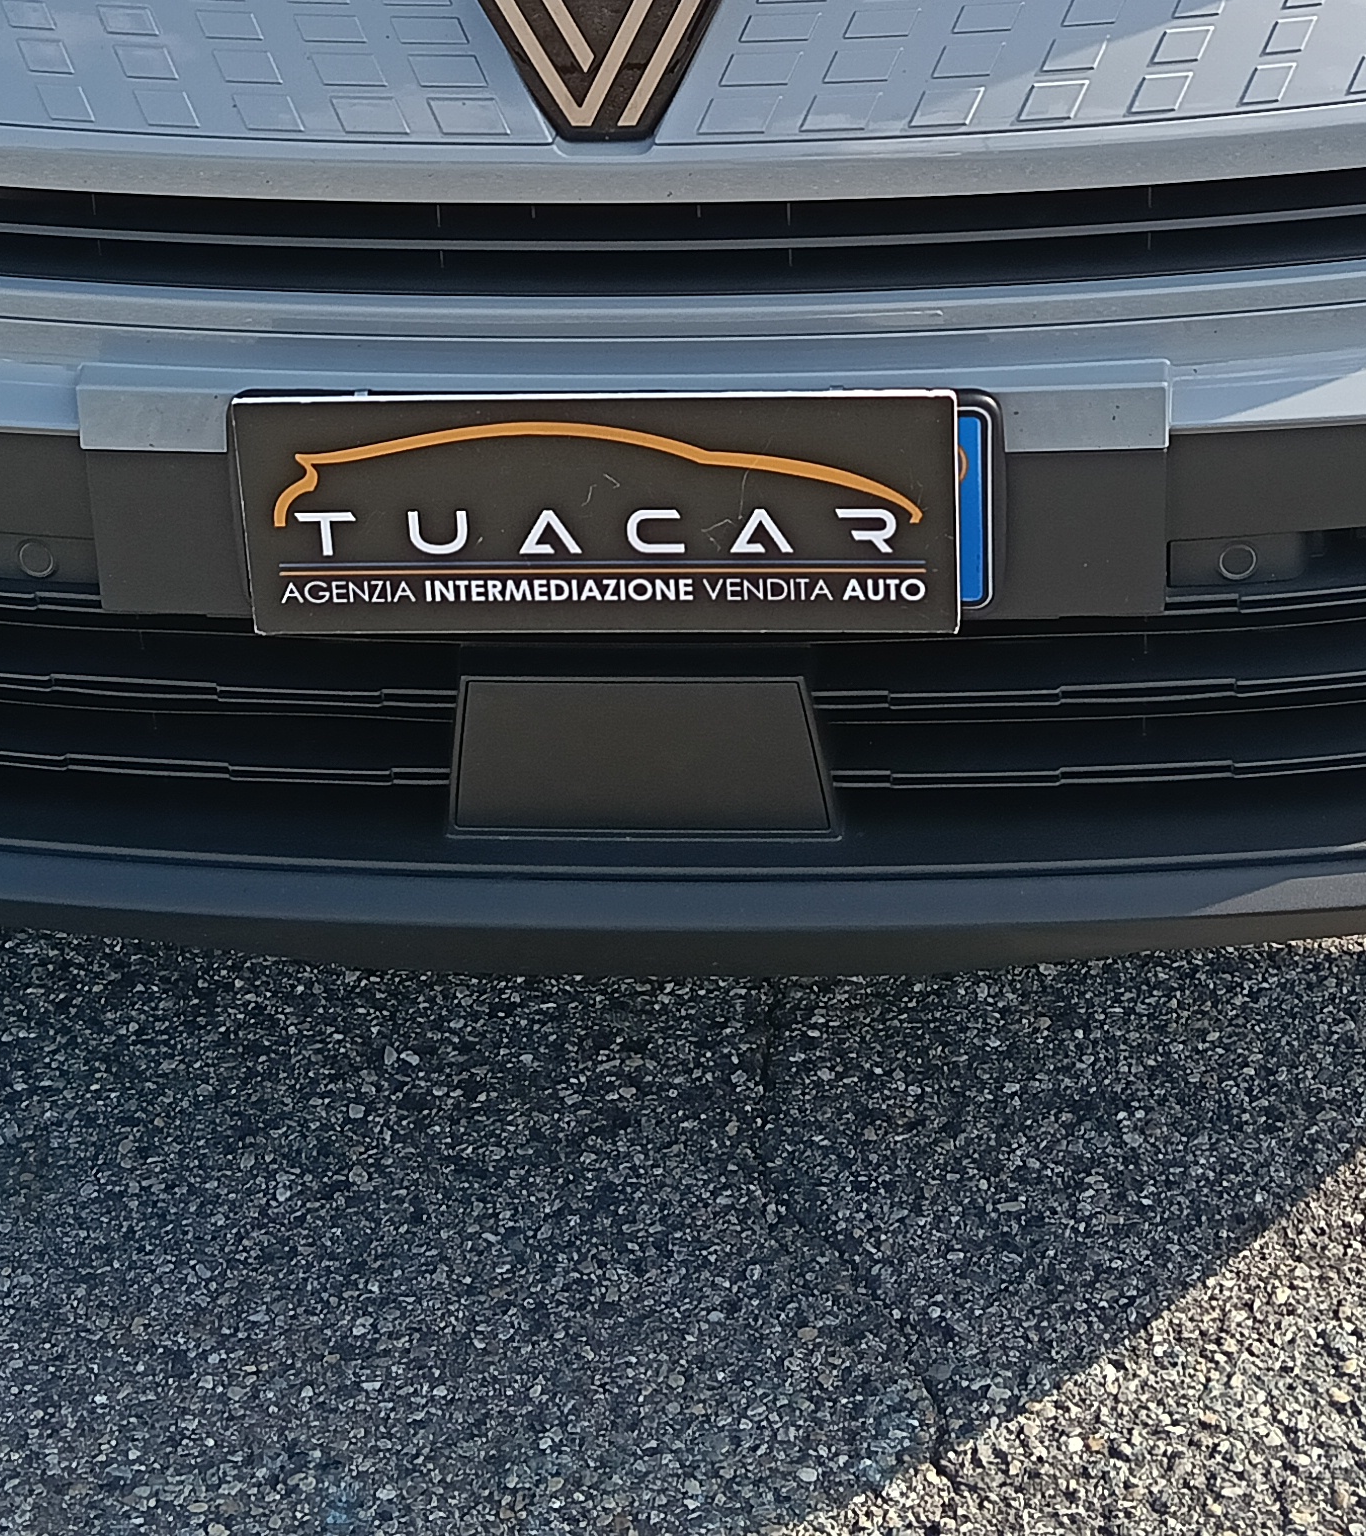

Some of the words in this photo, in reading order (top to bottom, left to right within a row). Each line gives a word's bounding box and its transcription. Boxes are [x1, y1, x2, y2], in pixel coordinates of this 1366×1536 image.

[294, 508, 897, 556] TUACAR
[281, 579, 417, 604] AGENZIA
[424, 577, 694, 603] INTERMEDIAZIONE
[702, 577, 834, 602] VENDITA
[842, 576, 927, 602] AUTO
